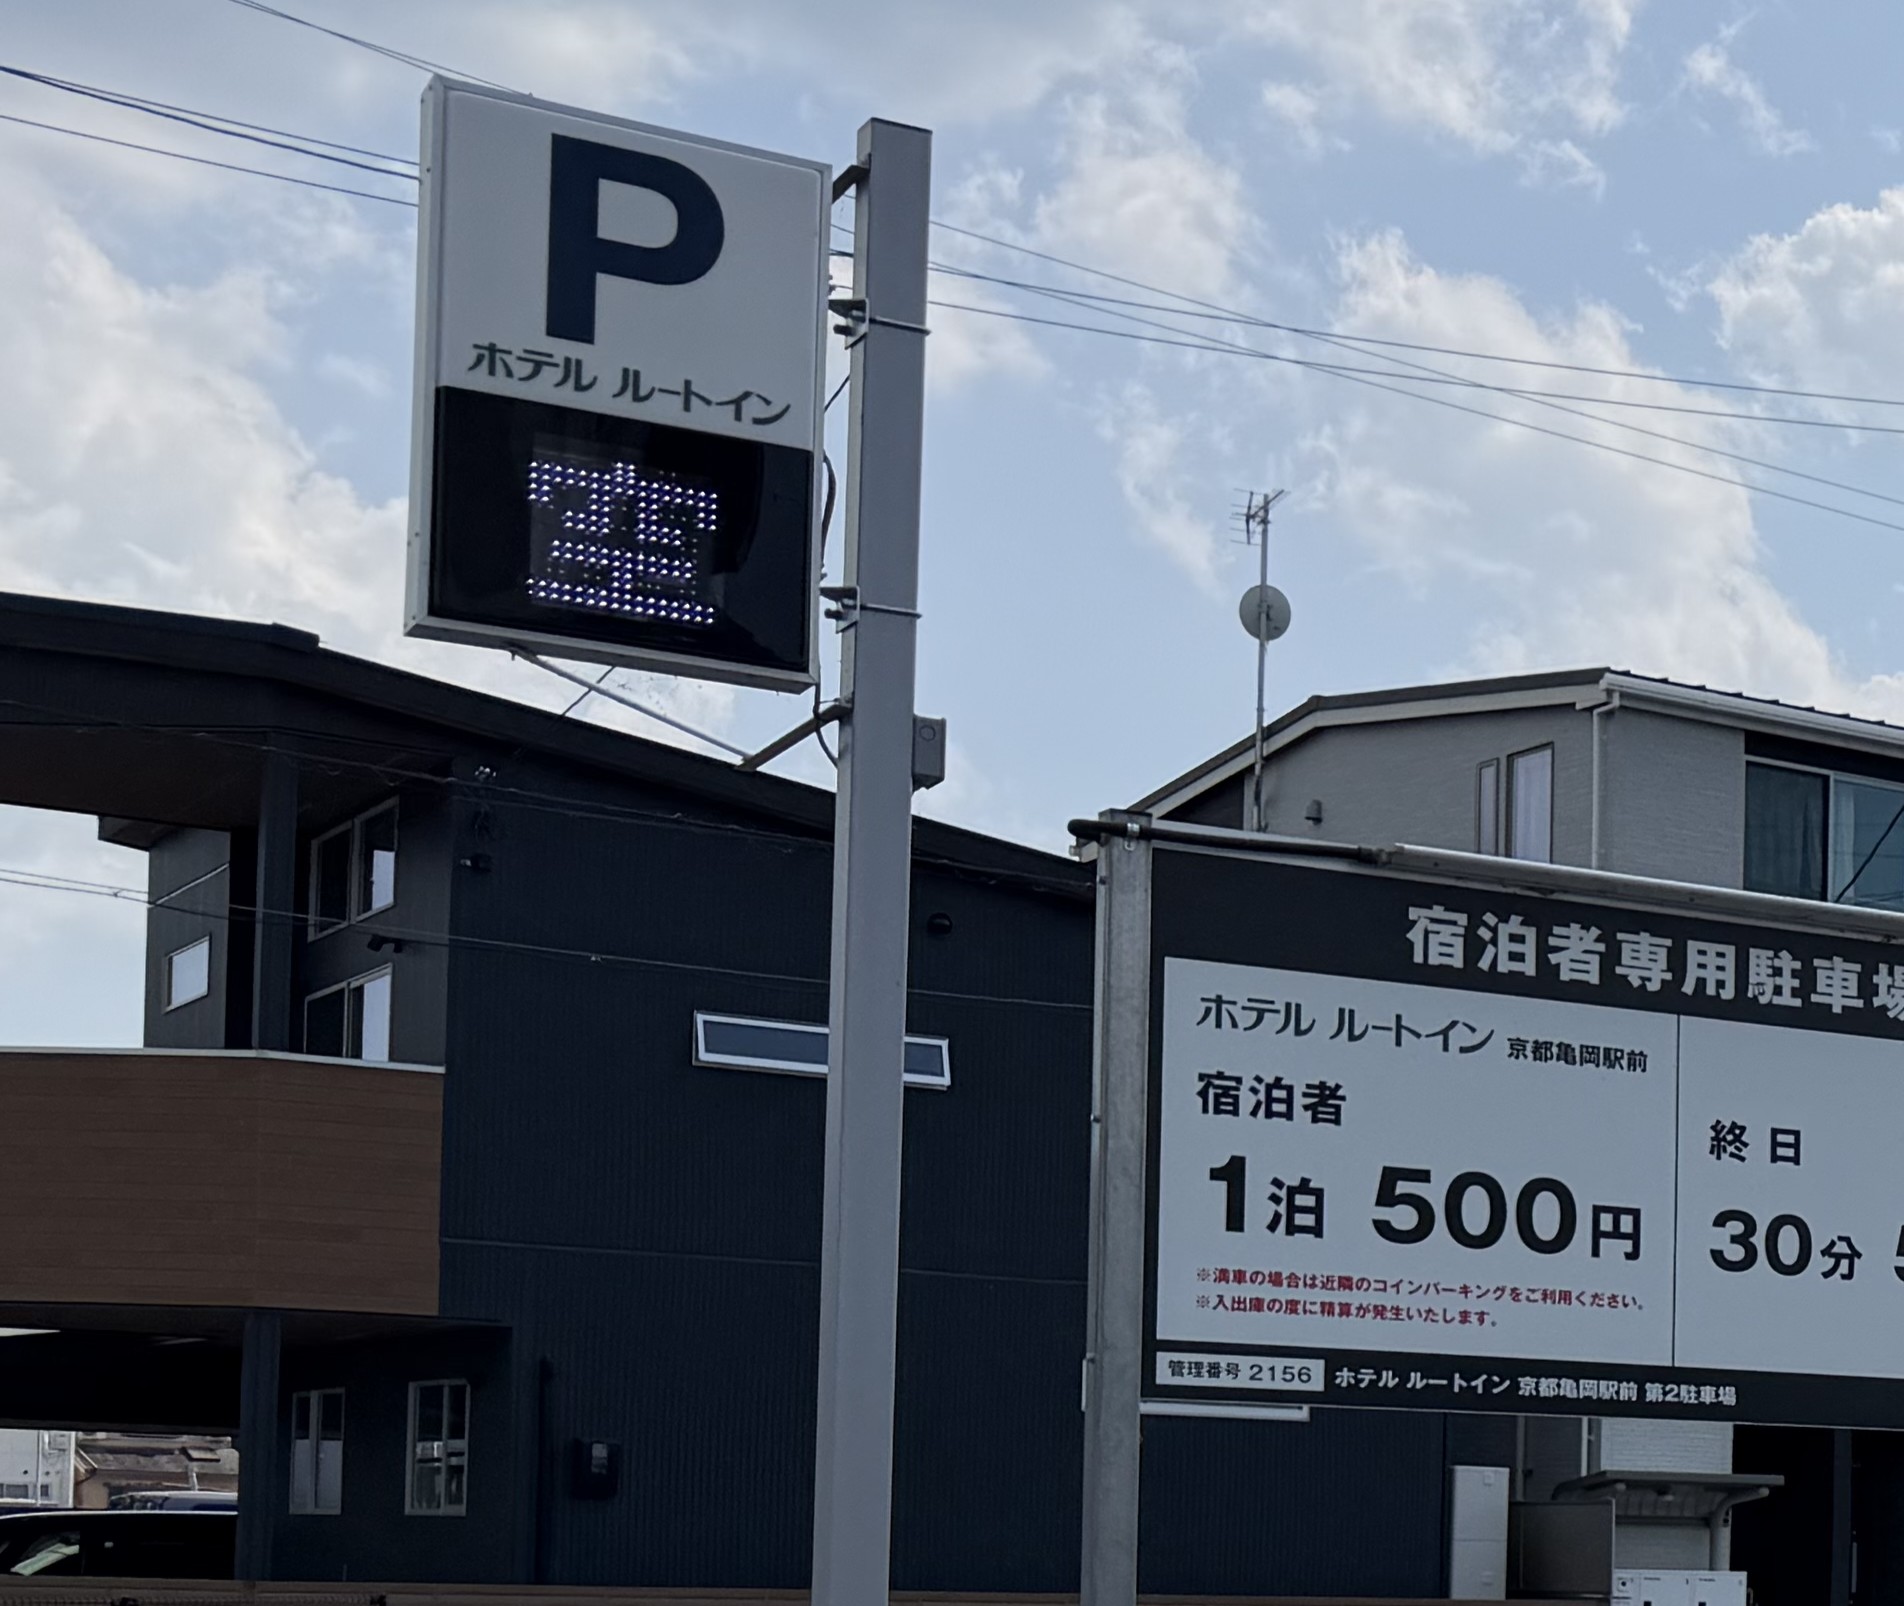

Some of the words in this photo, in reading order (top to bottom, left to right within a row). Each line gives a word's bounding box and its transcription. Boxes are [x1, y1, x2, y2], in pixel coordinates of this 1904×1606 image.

[545, 132, 725, 345] P
[467, 341, 598, 394] ホテル
[613, 366, 792, 426] ルートイン
[526, 460, 719, 627] 空
[1196, 994, 1317, 1038] ホテル
[1329, 1006, 1495, 1055] ルートイン
[1507, 1037, 1649, 1073] 京都亀岡駅前
[1196, 1071, 1347, 1127] 宿泊者
[1708, 1119, 1802, 1166] 終日
[1208, 1154, 1326, 1239] 1泊
[1371, 1164, 1642, 1262] 500円
[1709, 1209, 1863, 1282] 30分
[1168, 1359, 1241, 1380] 管理番号
[1249, 1363, 1312, 1384] 2156
[1334, 1367, 1399, 1389] ホテル
[1406, 1371, 1510, 1394] ルートイン
[1517, 1376, 1639, 1402] 京都亀岡駅前
[1645, 1382, 1737, 1407] 第2駐車場
